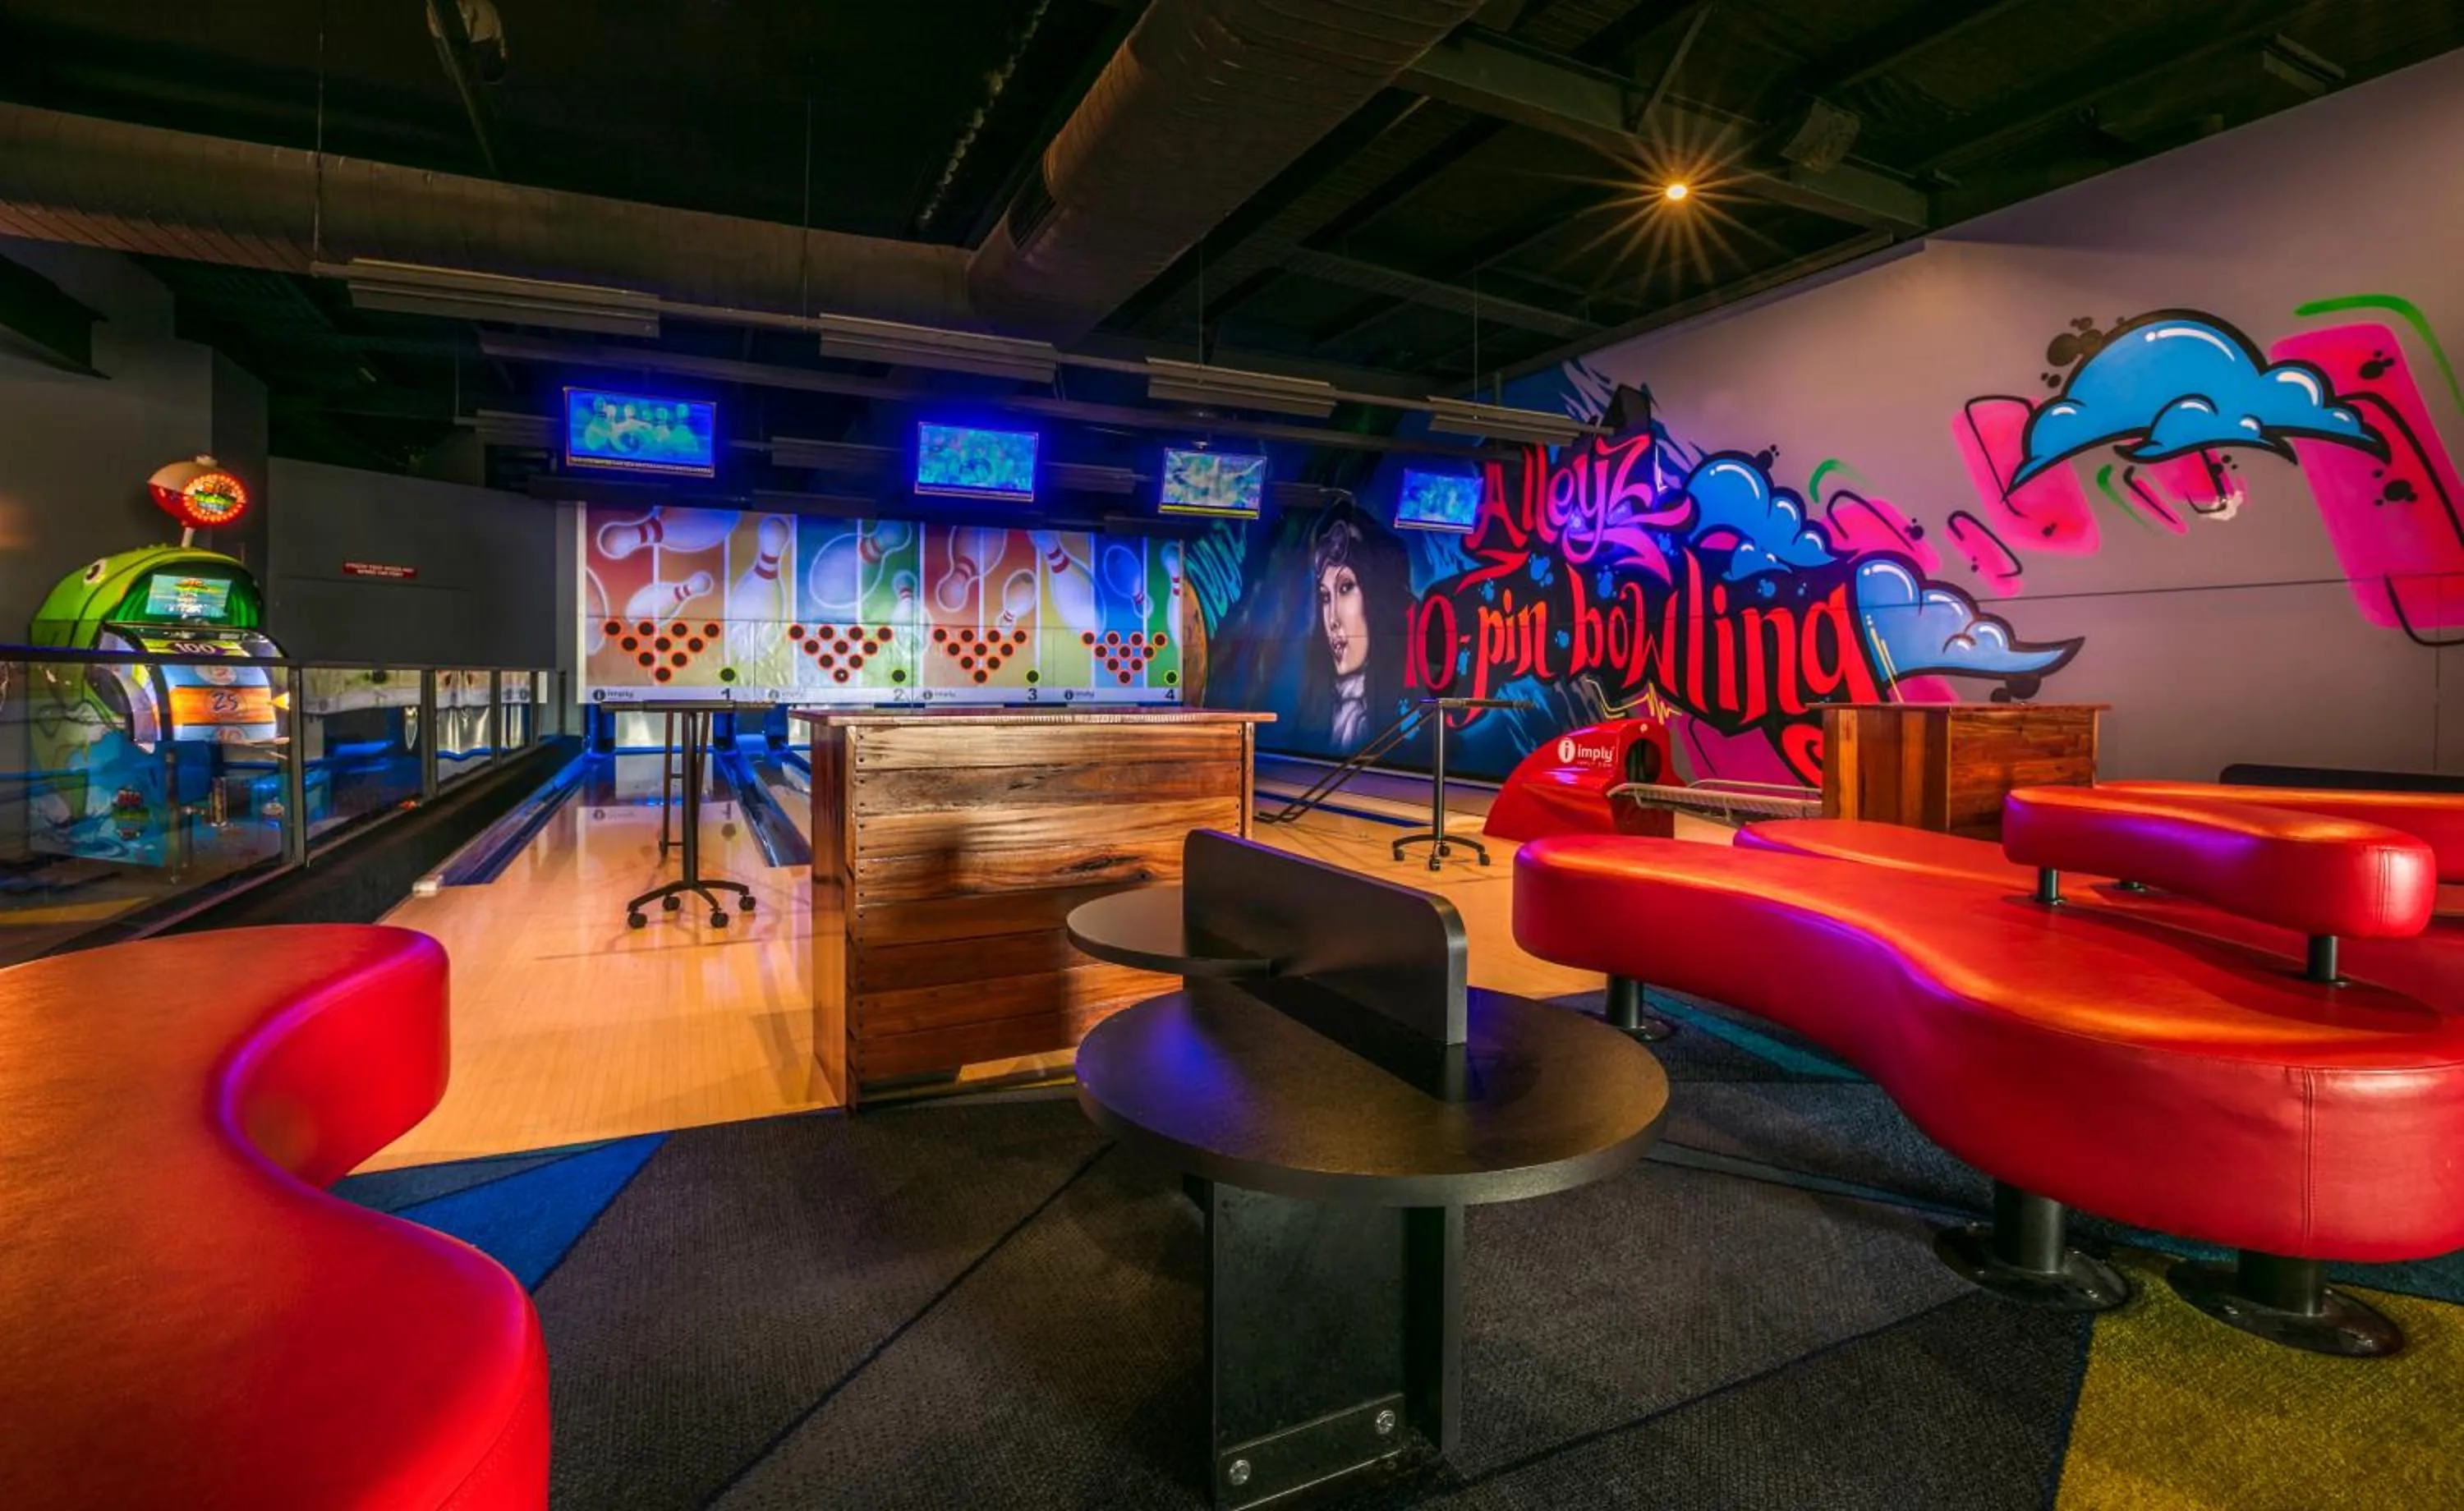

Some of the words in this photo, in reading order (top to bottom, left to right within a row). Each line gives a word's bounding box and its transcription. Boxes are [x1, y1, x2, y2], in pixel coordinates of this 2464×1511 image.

[174, 642, 216, 654] 100
[1565, 548, 1881, 790] bowling
[720, 687, 731, 699] 1
[893, 688, 903, 701] 2
[1027, 688, 1038, 700] 3
[1165, 689, 1175, 700] 4
[212, 691, 239, 712] 25
[1577, 744, 1613, 763] imply
